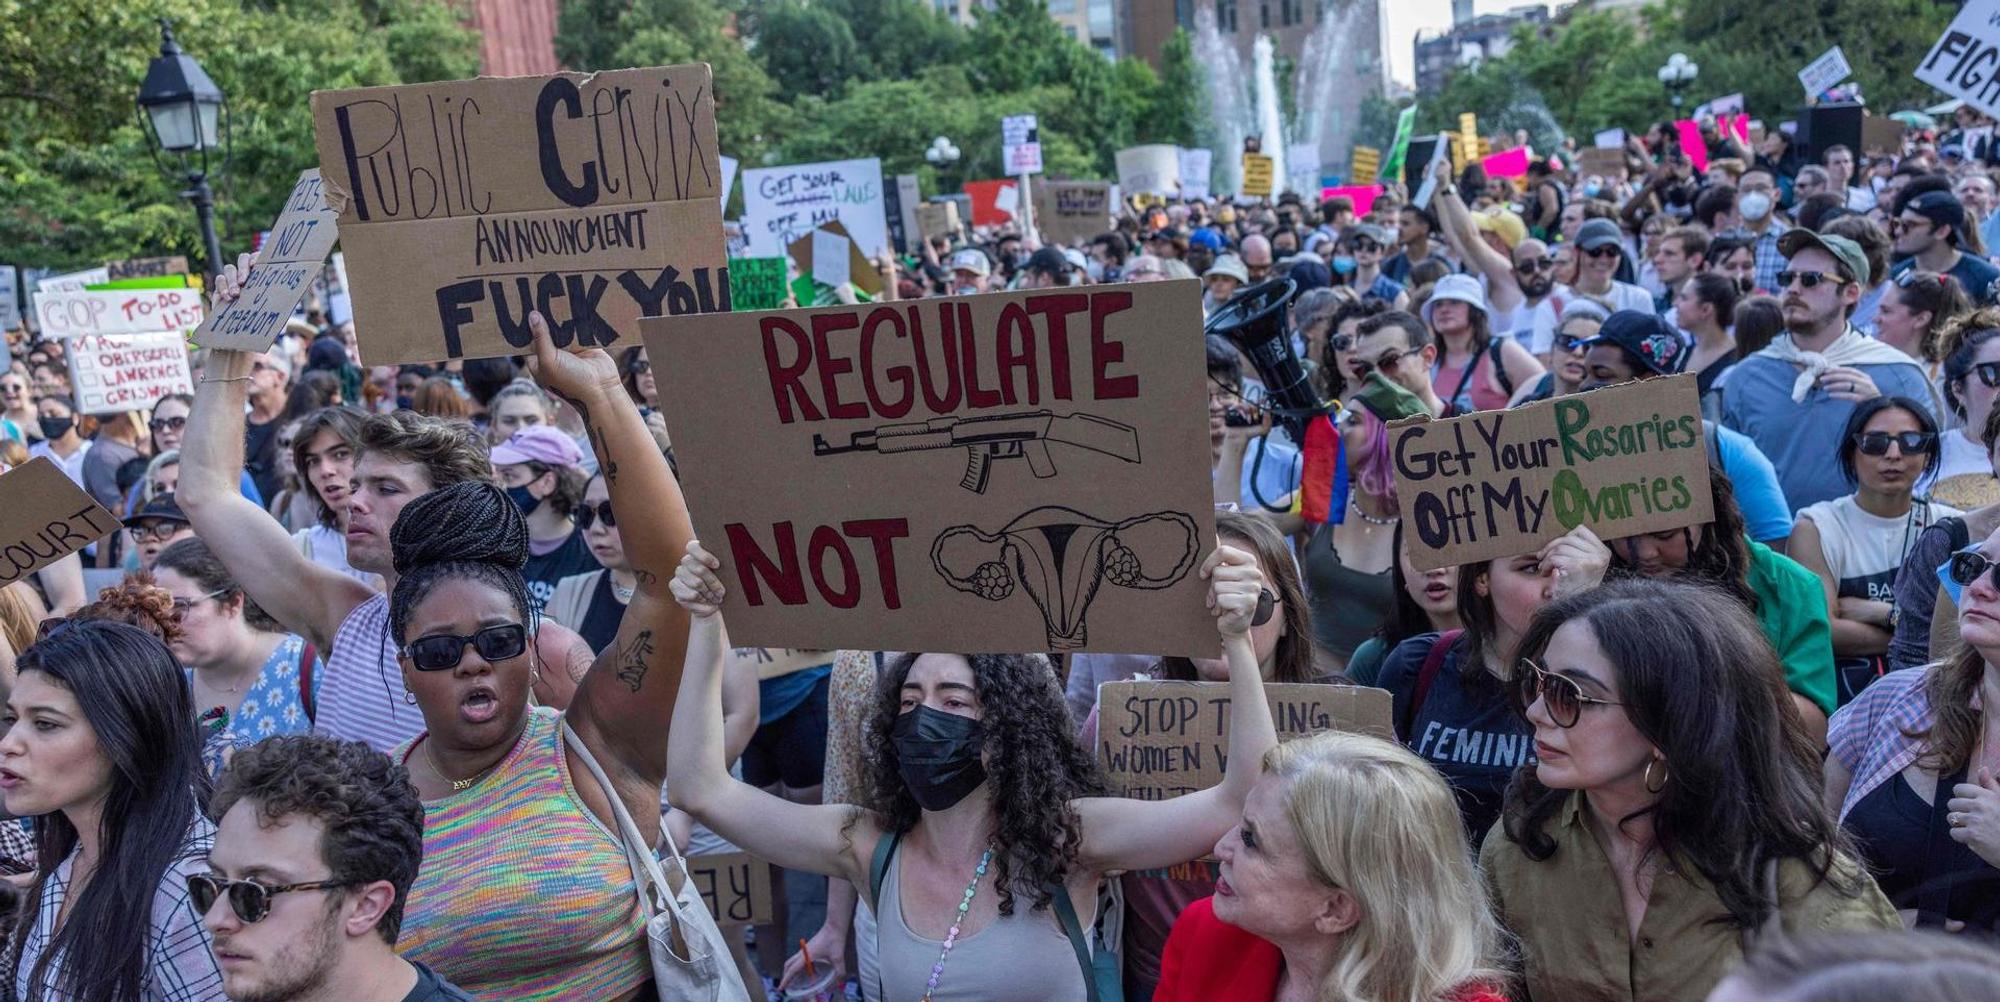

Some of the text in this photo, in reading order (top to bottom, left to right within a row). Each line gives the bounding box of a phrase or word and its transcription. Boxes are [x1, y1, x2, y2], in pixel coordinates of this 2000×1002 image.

[334, 77, 712, 221] Public Cervix
[760, 171, 845, 199] GET YOUR
[271, 220, 319, 259] NOT
[475, 209, 648, 266] ANNOUNCMENT
[767, 212, 799, 233] OFF
[43, 292, 182, 331] GOP TO-DO
[162, 303, 202, 331] LIST
[210, 297, 280, 337] freedom
[435, 272, 620, 359] FUCK
[103, 365, 182, 387] LAWRENCE
[759, 291, 1139, 424] REGULATE
[1395, 399, 1696, 481] Get Your Rosaries
[1413, 469, 1692, 549] Off My Ovaries
[724, 518, 909, 610] NOT
[1868, 582, 1892, 598] BA
[1119, 696, 1331, 738] STOP TING
[1104, 740, 1201, 775] WOMEN
